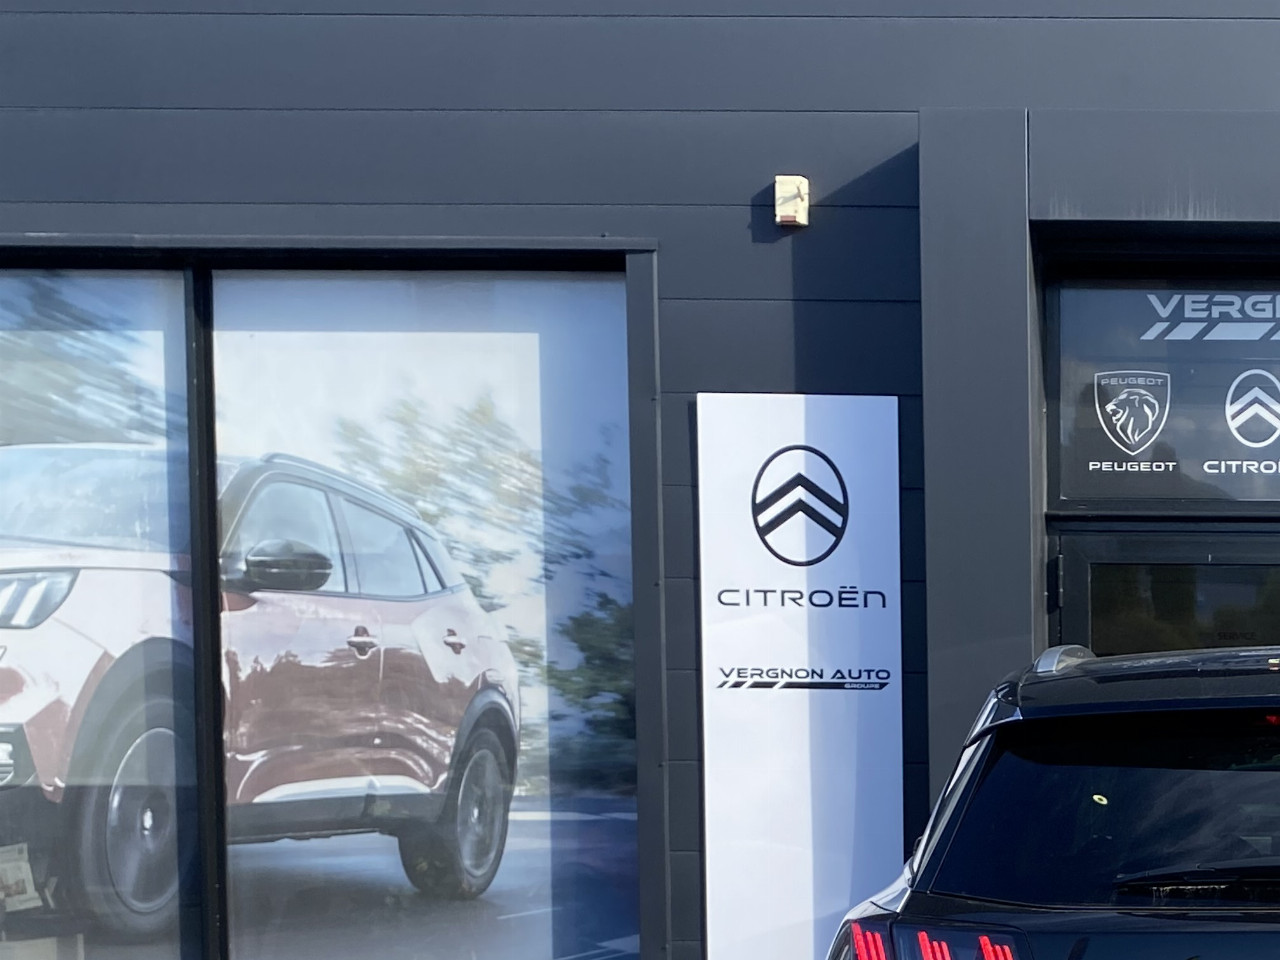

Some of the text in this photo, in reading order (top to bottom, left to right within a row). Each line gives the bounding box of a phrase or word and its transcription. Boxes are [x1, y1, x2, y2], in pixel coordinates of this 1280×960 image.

[1100, 377, 1165, 387] PEUGEOT
[1089, 461, 1177, 472] PEUGEOT
[719, 667, 891, 681] VERGNON AUTO
